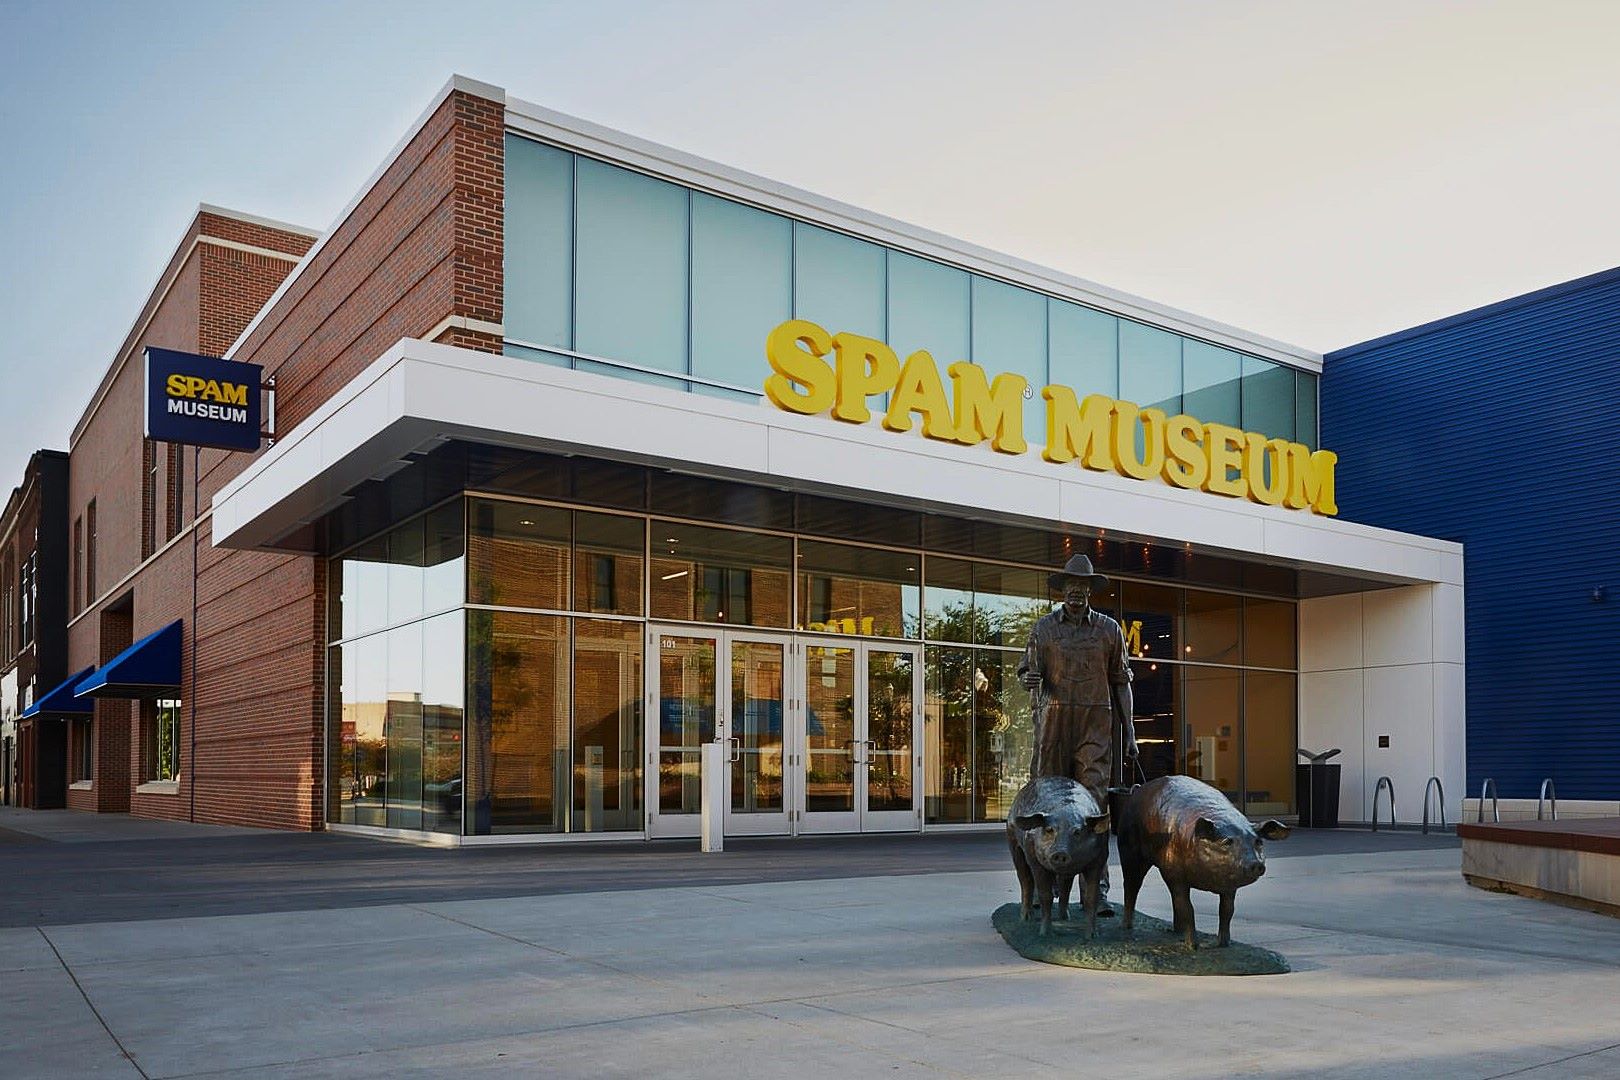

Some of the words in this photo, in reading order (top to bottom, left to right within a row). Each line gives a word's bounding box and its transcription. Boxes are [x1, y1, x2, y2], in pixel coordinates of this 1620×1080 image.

[166, 374, 248, 406] SPAM
[167, 398, 247, 424] MUSEUM
[1042, 384, 1338, 516] MUSEUM
[662, 639, 676, 648] 101
